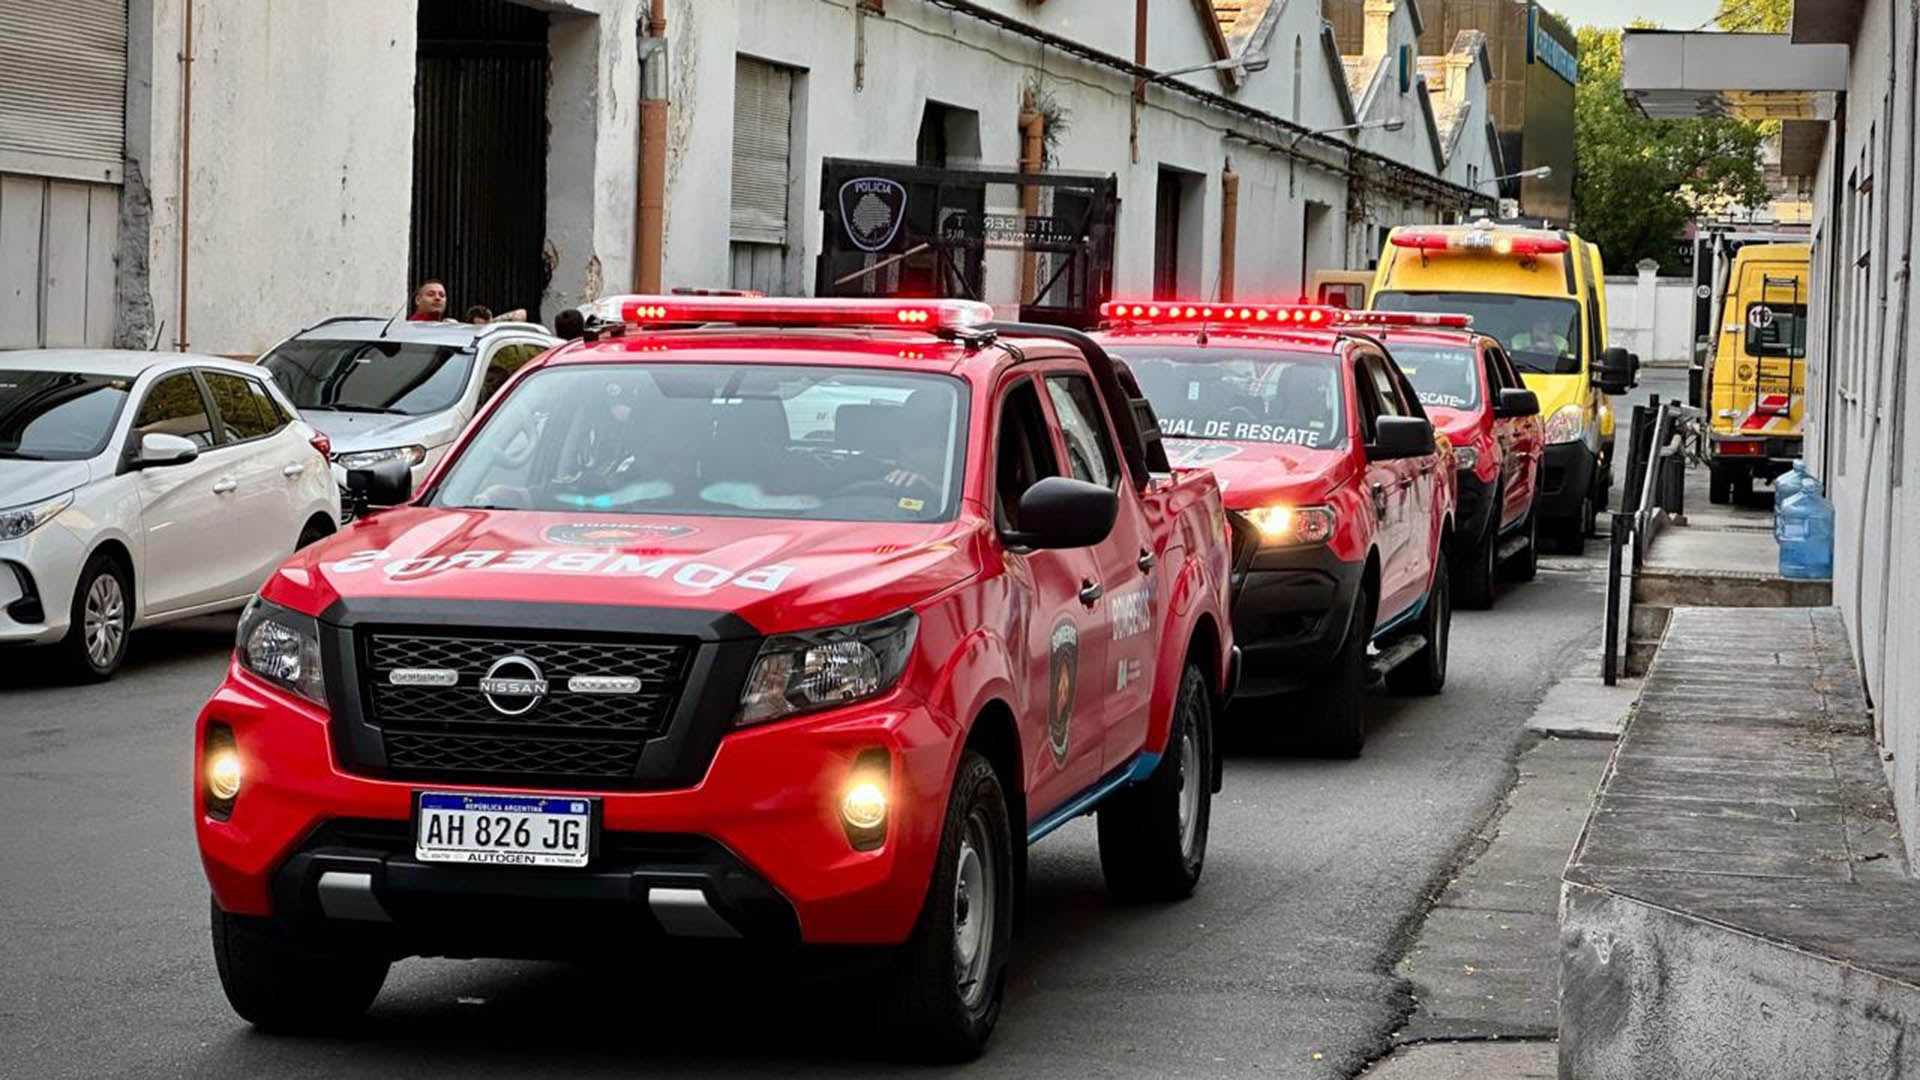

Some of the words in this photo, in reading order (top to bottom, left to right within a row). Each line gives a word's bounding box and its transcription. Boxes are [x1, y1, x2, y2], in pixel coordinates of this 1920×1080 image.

[855, 182, 892, 194] POLICIA
[1416, 391, 1459, 407] SCATE
[1204, 420, 1231, 437] DE
[1235, 422, 1320, 447] RESCATE
[480, 681, 547, 695] NISSAN
[504, 804, 543, 813] ARGENTINA
[427, 813, 465, 845] AH
[475, 815, 531, 848] 826
[543, 818, 580, 850] JG
[467, 852, 536, 864] AUTOGEN
